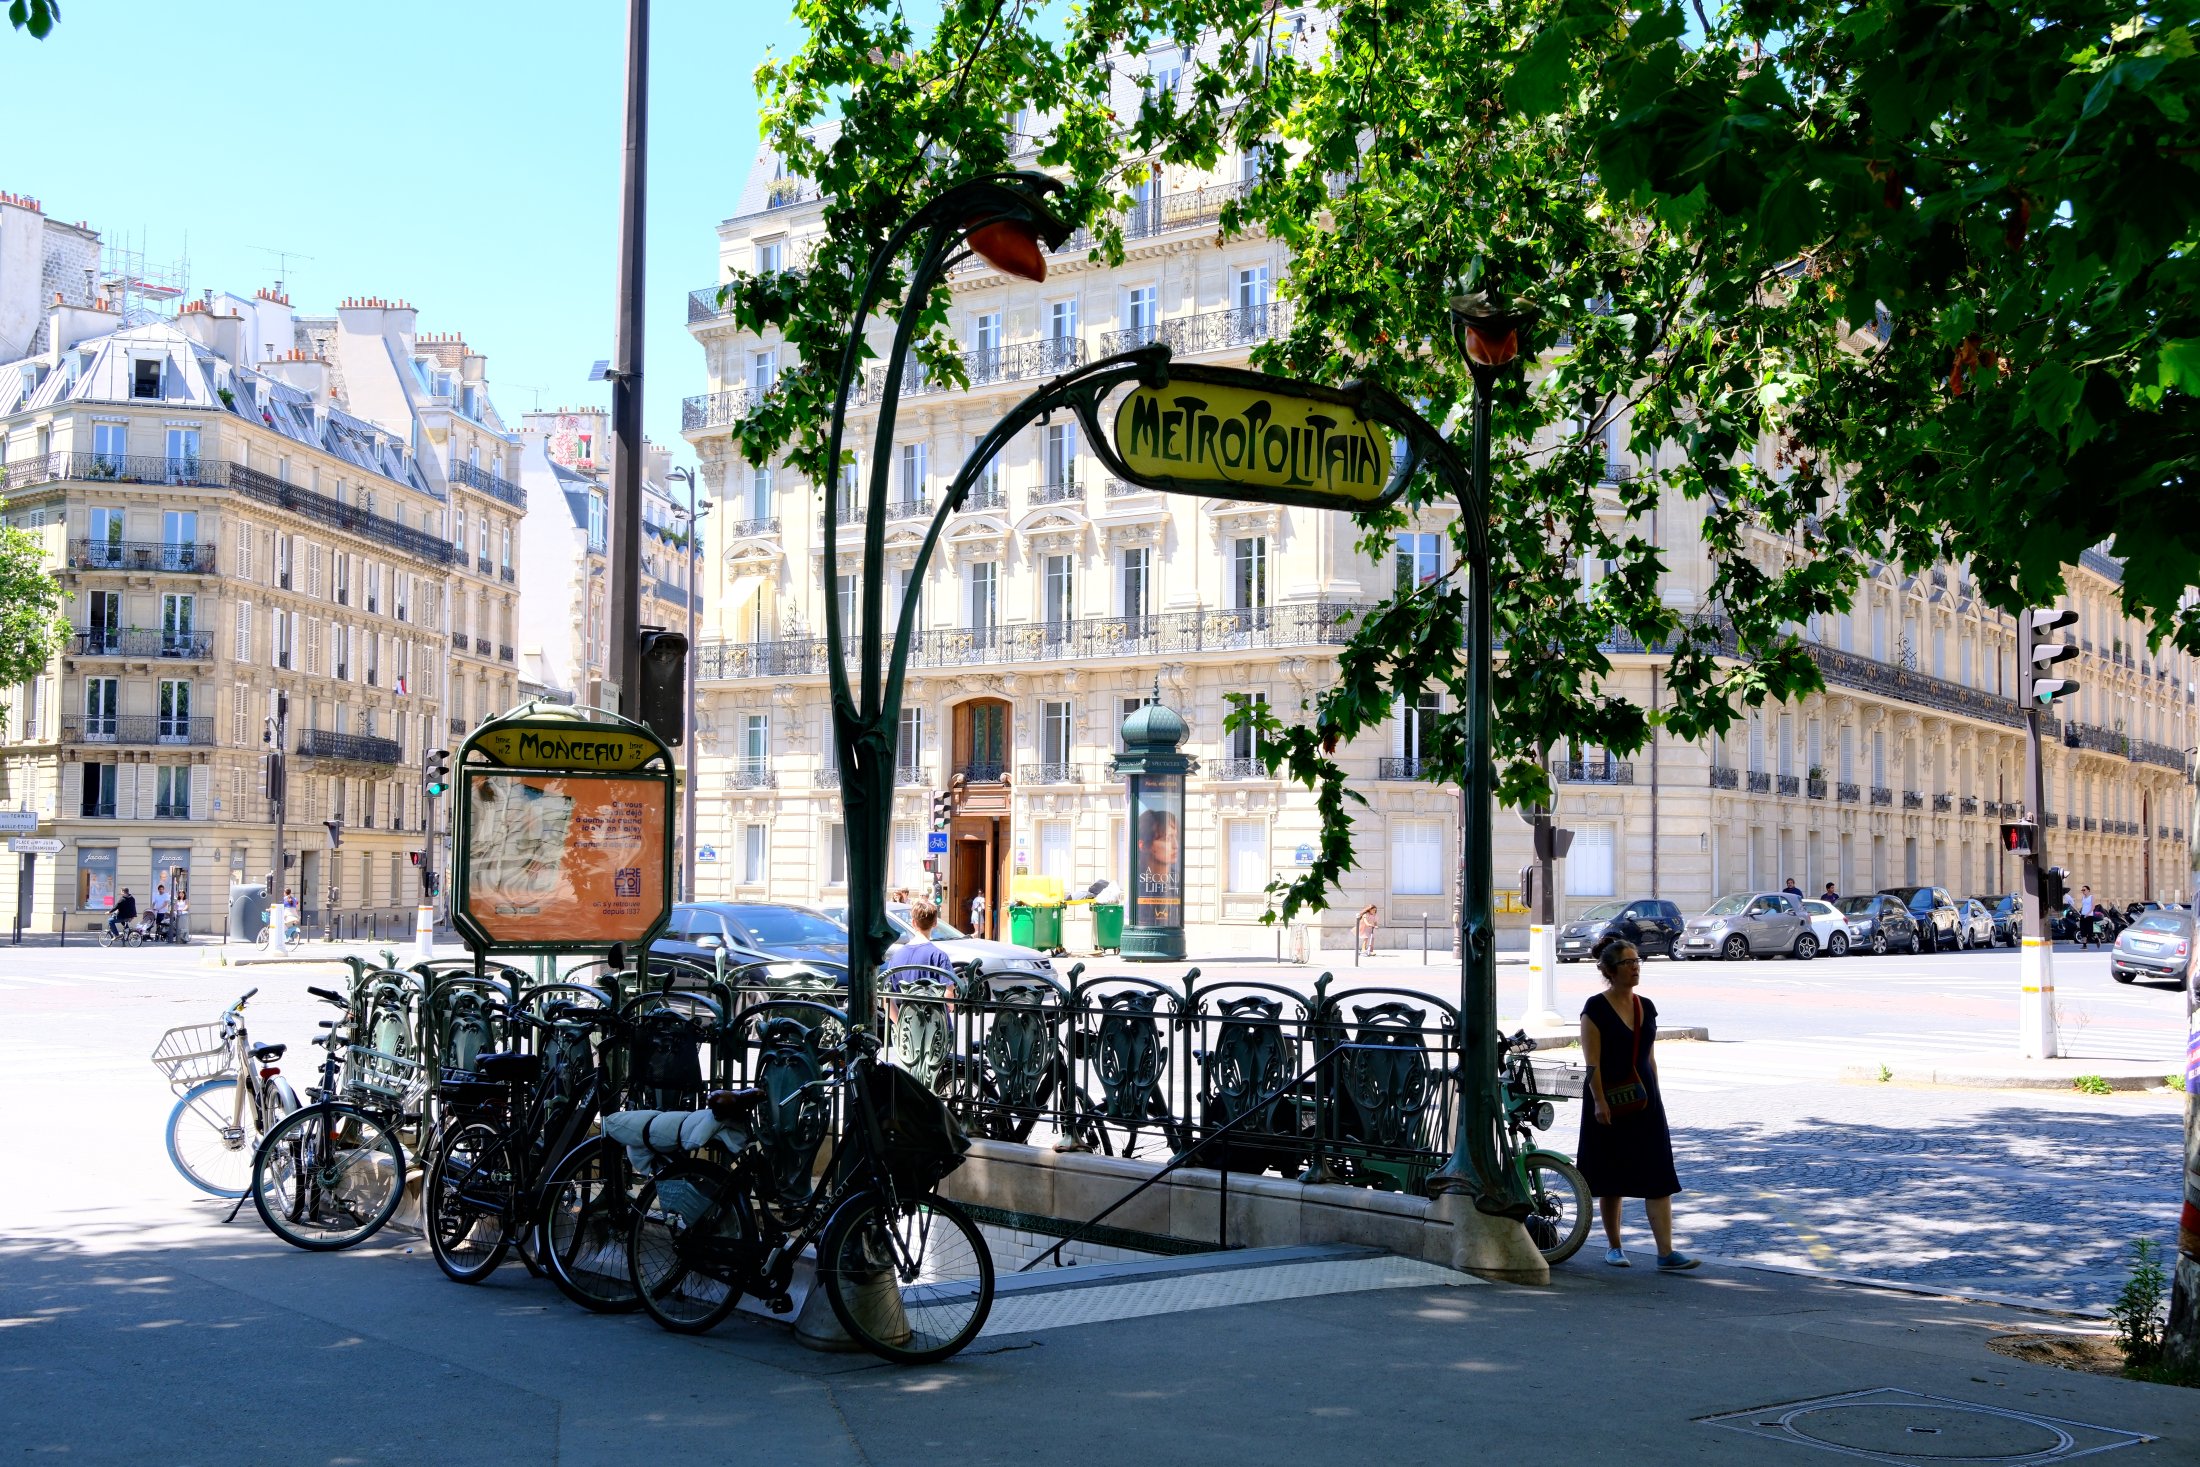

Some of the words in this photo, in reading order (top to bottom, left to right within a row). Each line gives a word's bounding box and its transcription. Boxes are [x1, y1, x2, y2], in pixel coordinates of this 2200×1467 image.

[1130, 395, 1380, 490] METROPOLITAIN
[505, 744, 511, 755] 2
[519, 732, 623, 766] MONCEAU
[635, 750, 641, 760] 2
[1140, 872, 1180, 883] SECOND
[1145, 882, 1168, 893] LIFE
[801, 1180, 849, 1238] PEUGEOT
